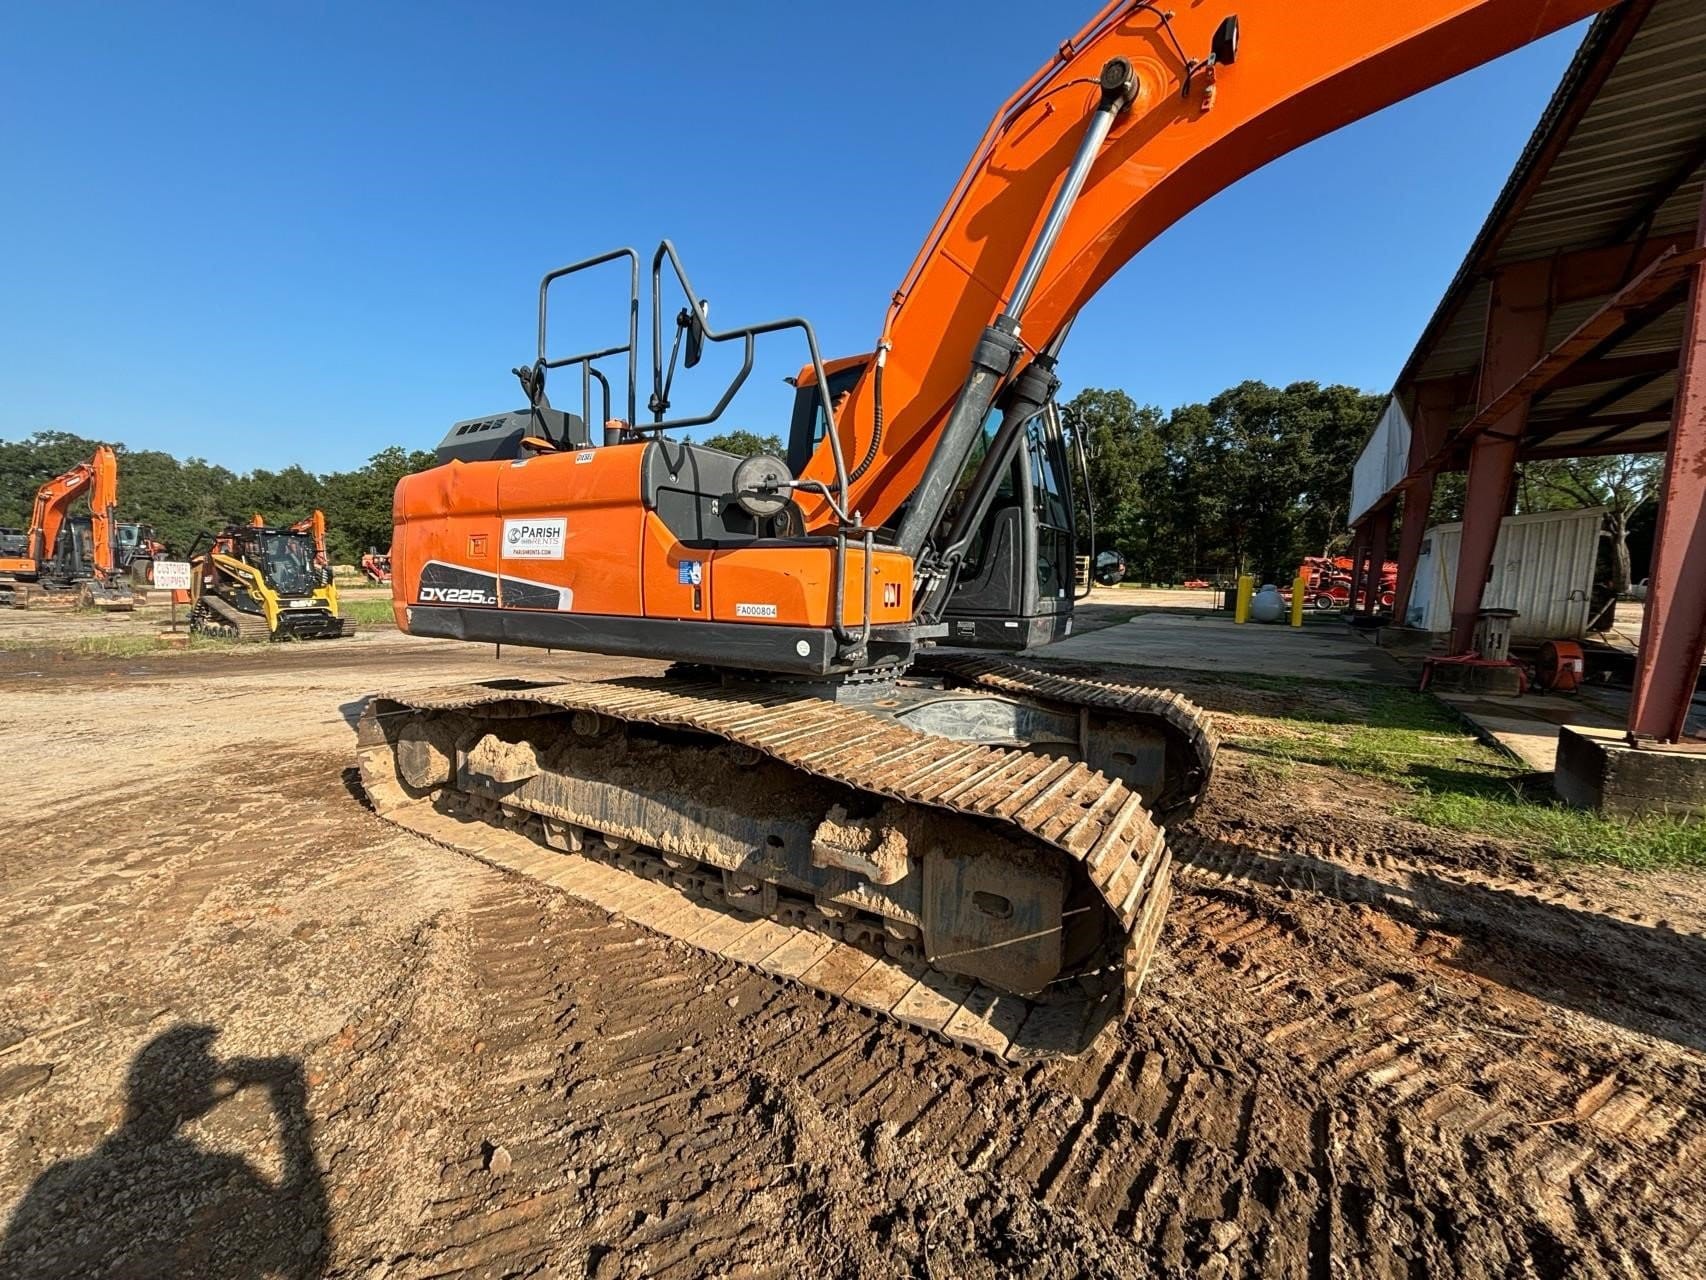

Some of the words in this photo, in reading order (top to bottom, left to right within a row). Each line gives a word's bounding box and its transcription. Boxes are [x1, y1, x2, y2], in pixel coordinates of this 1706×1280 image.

[520, 526, 561, 538] PARISH
[532, 537, 560, 545] RENTS
[737, 605, 776, 615] FA000804
